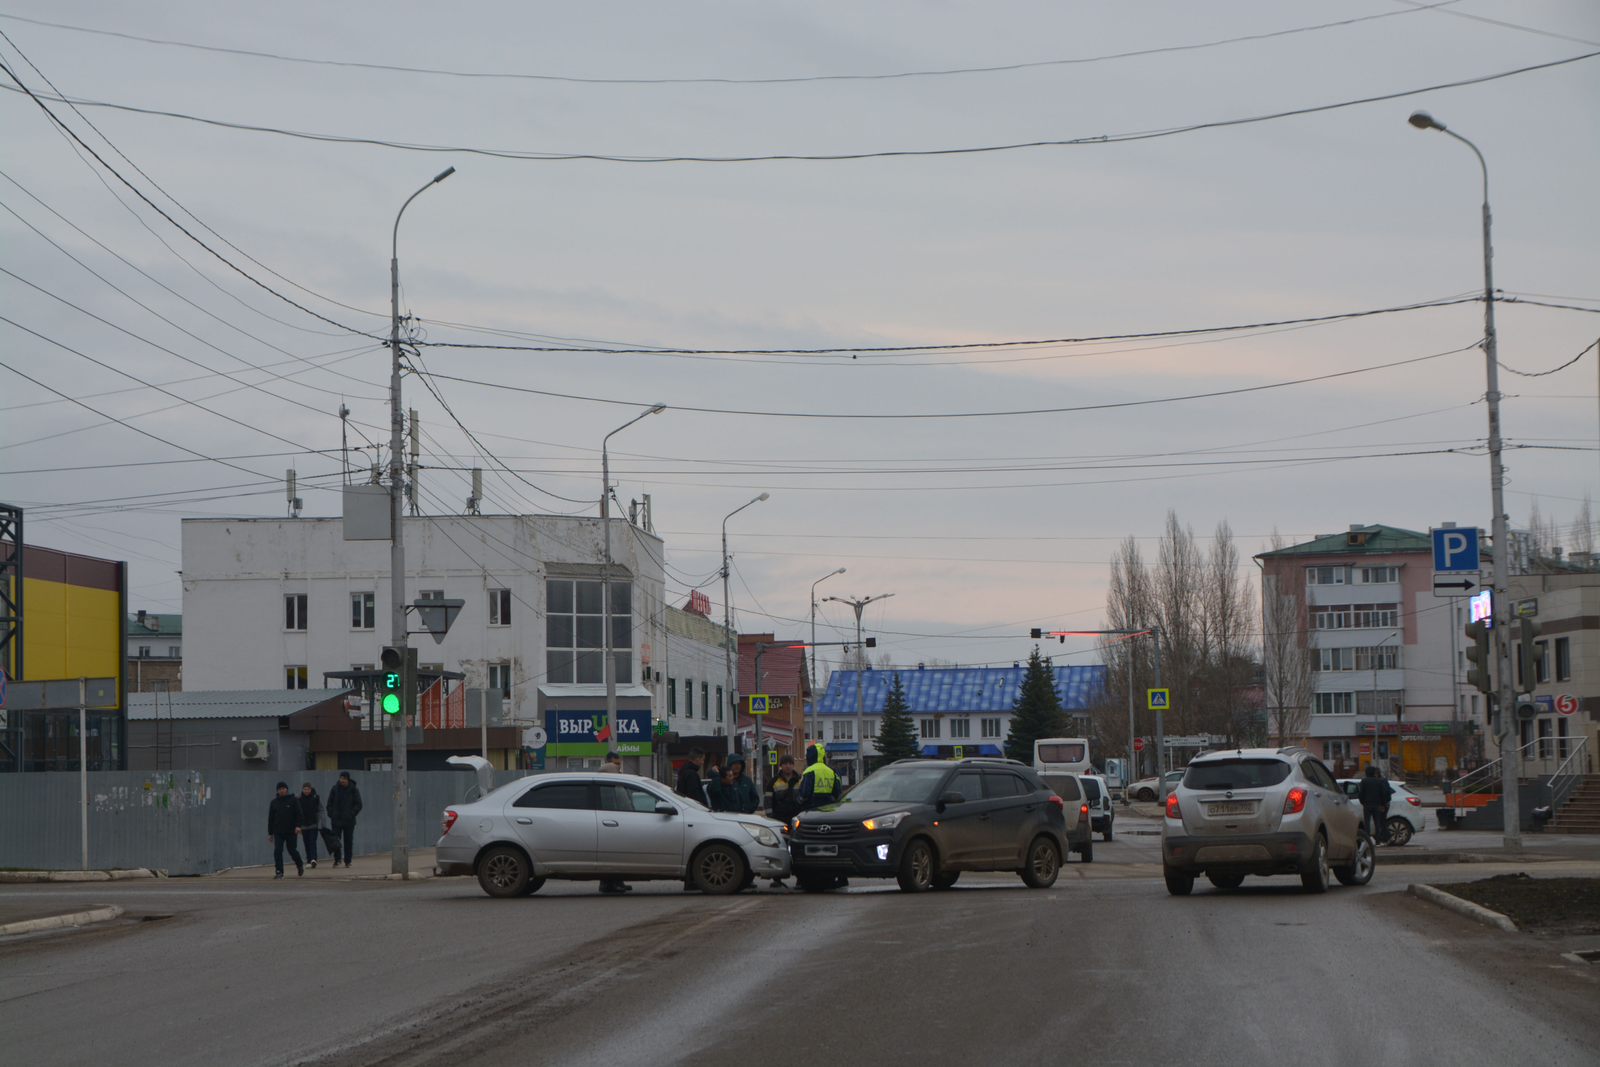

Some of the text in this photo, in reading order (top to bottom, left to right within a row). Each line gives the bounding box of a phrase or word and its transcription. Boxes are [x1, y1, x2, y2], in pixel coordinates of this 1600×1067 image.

[1443, 533, 1468, 567] P
[387, 674, 400, 688] 27
[559, 715, 640, 735] ВЫРУКА
[617, 744, 640, 752] АЙМЫ
